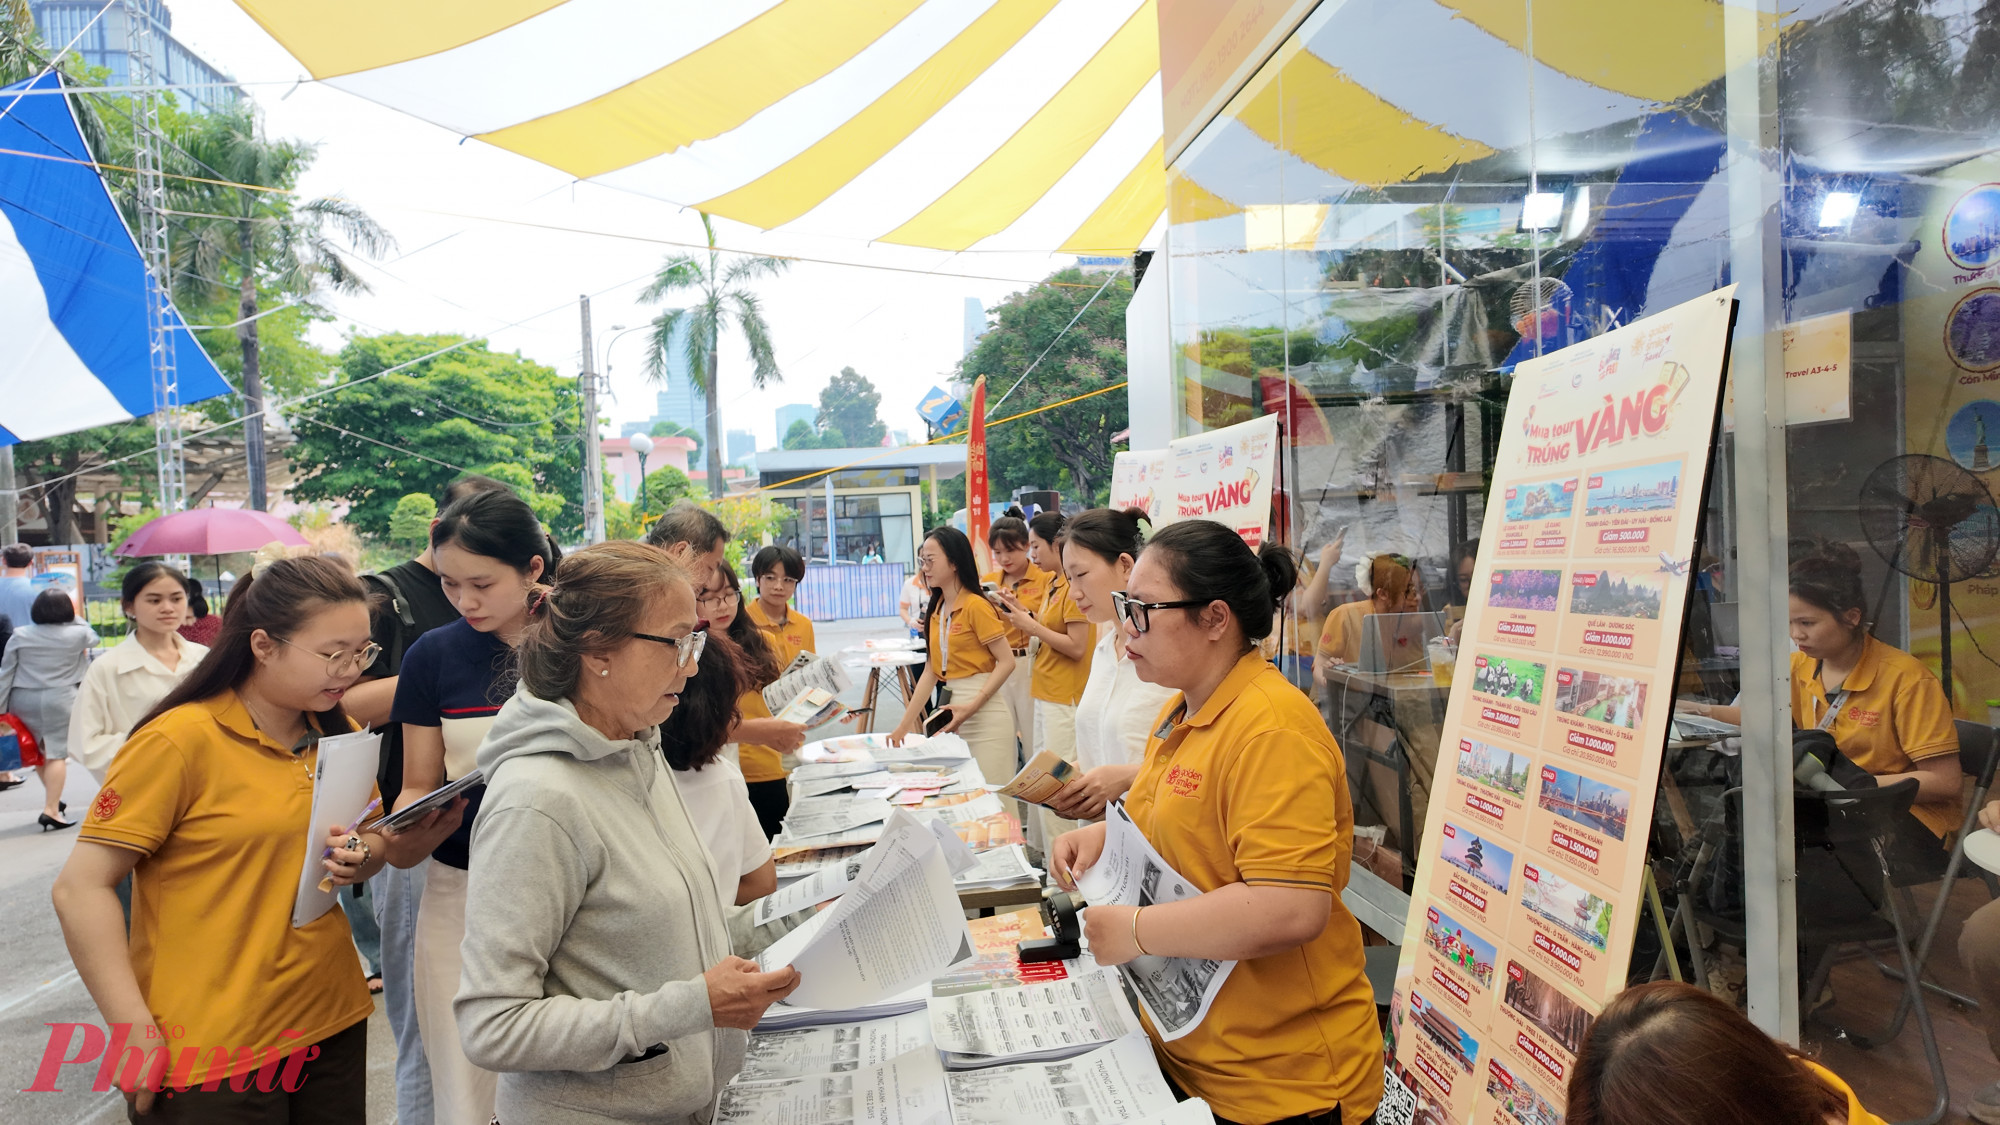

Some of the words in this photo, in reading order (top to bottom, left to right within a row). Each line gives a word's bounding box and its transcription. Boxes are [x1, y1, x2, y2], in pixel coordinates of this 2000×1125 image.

[1785, 369, 1808, 378] Travel
[1811, 364, 1838, 375] A3-4-5
[1574, 384, 1670, 457] VÀNG
[1530, 423, 1550, 440] Mua
[1552, 420, 1576, 438] tour
[1528, 440, 1570, 465] TRÚNG
[1177, 492, 1191, 503] Mua
[1192, 492, 1205, 501] tour
[1204, 479, 1250, 514] VÀNG
[1177, 504, 1203, 516] TRÚNG
[1602, 531, 1618, 541] Giảm
[1619, 530, 1645, 540] 500.000
[1968, 584, 1998, 596] Pháp
[1499, 623, 1511, 632] Giảm
[1511, 625, 1535, 634] 2.000.000
[1585, 631, 1601, 642] Giảm
[1602, 634, 1631, 646] 1.000.000
[1483, 708, 1495, 719] Giảm
[1569, 732, 1584, 744] Giảm
[1585, 737, 1614, 753] 1.000.000
[1606, 759, 1617, 768] VND
[1180, 768, 1202, 782] golden
[1176, 778, 1192, 790] smile
[1468, 796, 1480, 807] Giảm
[1480, 800, 1502, 816] 1.000.000
[1553, 833, 1569, 847] Giảm
[1569, 841, 1597, 860] 1.500.000
[1588, 864, 1599, 876] VND
[1450, 882, 1462, 895] Giảm
[1463, 888, 1484, 909] 1.000.000
[1535, 934, 1550, 950] Giảm
[1551, 944, 1580, 969] 7.000.000
[1434, 969, 1445, 983] Giảm
[1445, 978, 1468, 1001] 1.000.000
[1573, 972, 1584, 987] VND
[1526, 1025, 1536, 1039] FREE
[1539, 1035, 1548, 1047] DAY
[1509, 1044, 1518, 1056] Giá
[1518, 1035, 1534, 1053] Giảm
[1534, 1046, 1563, 1076] 1.000.000
[1416, 1055, 1428, 1072] Giảm
[1428, 1067, 1450, 1093] 1.000.000
